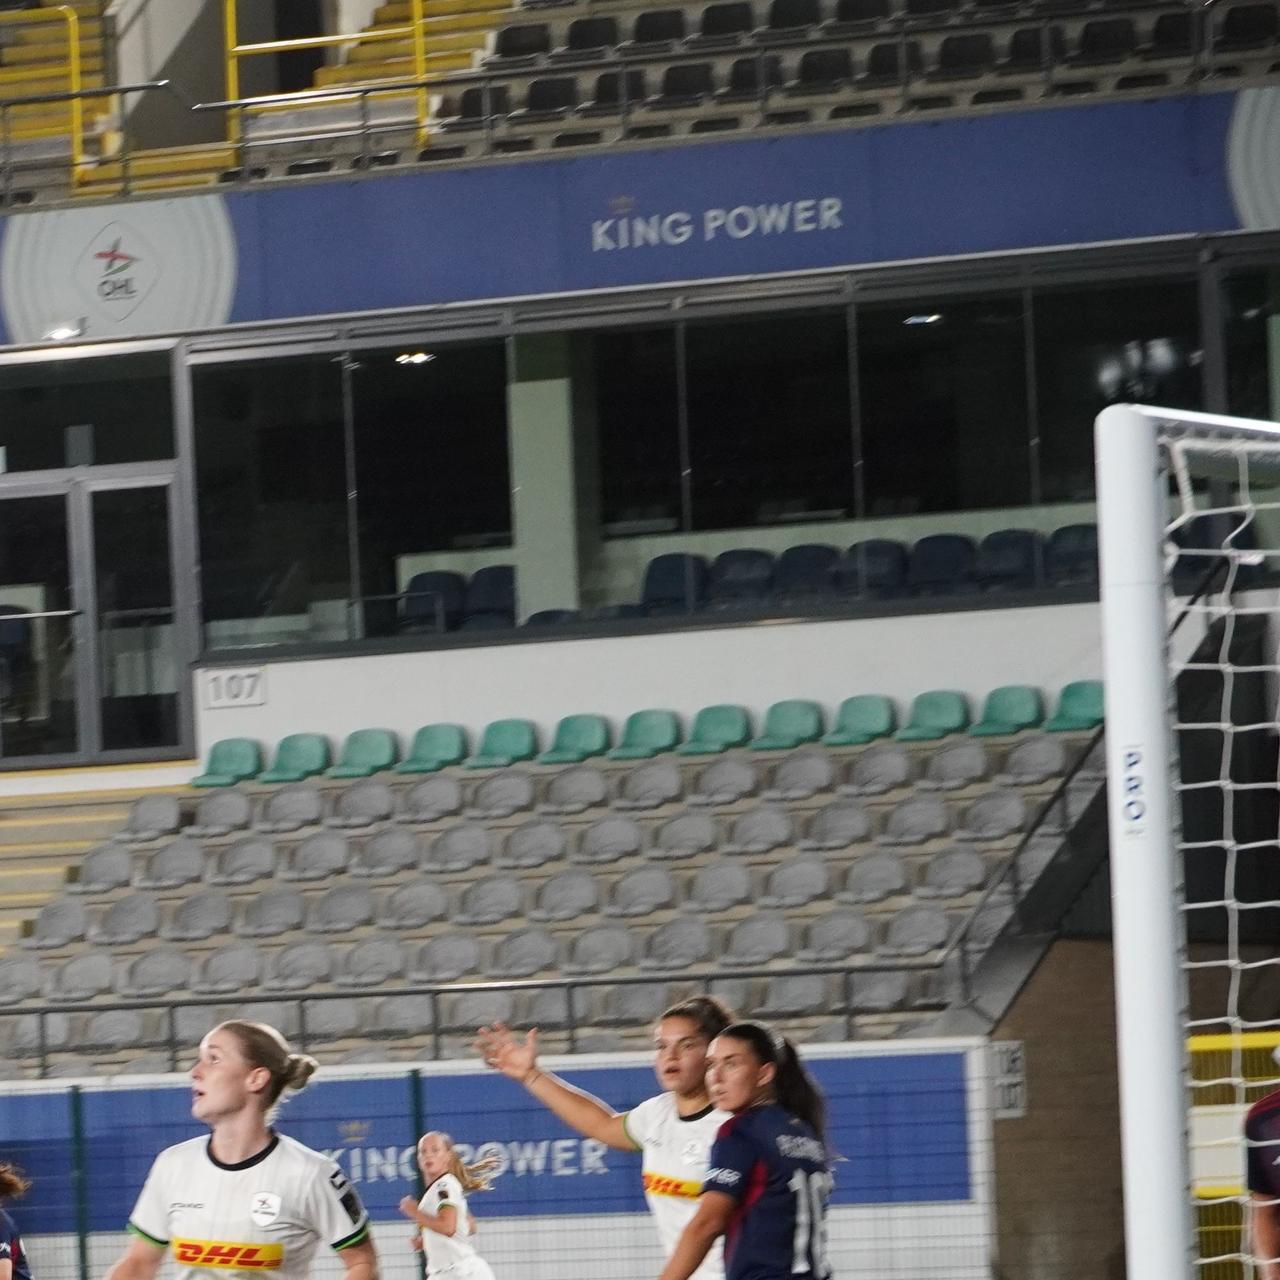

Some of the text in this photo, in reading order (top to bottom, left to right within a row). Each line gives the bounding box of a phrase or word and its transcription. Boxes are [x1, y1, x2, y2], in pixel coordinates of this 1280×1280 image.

[592, 198, 843, 251] KING POWER
[209, 674, 262, 701] 107
[178, 1243, 267, 1267] DHL
